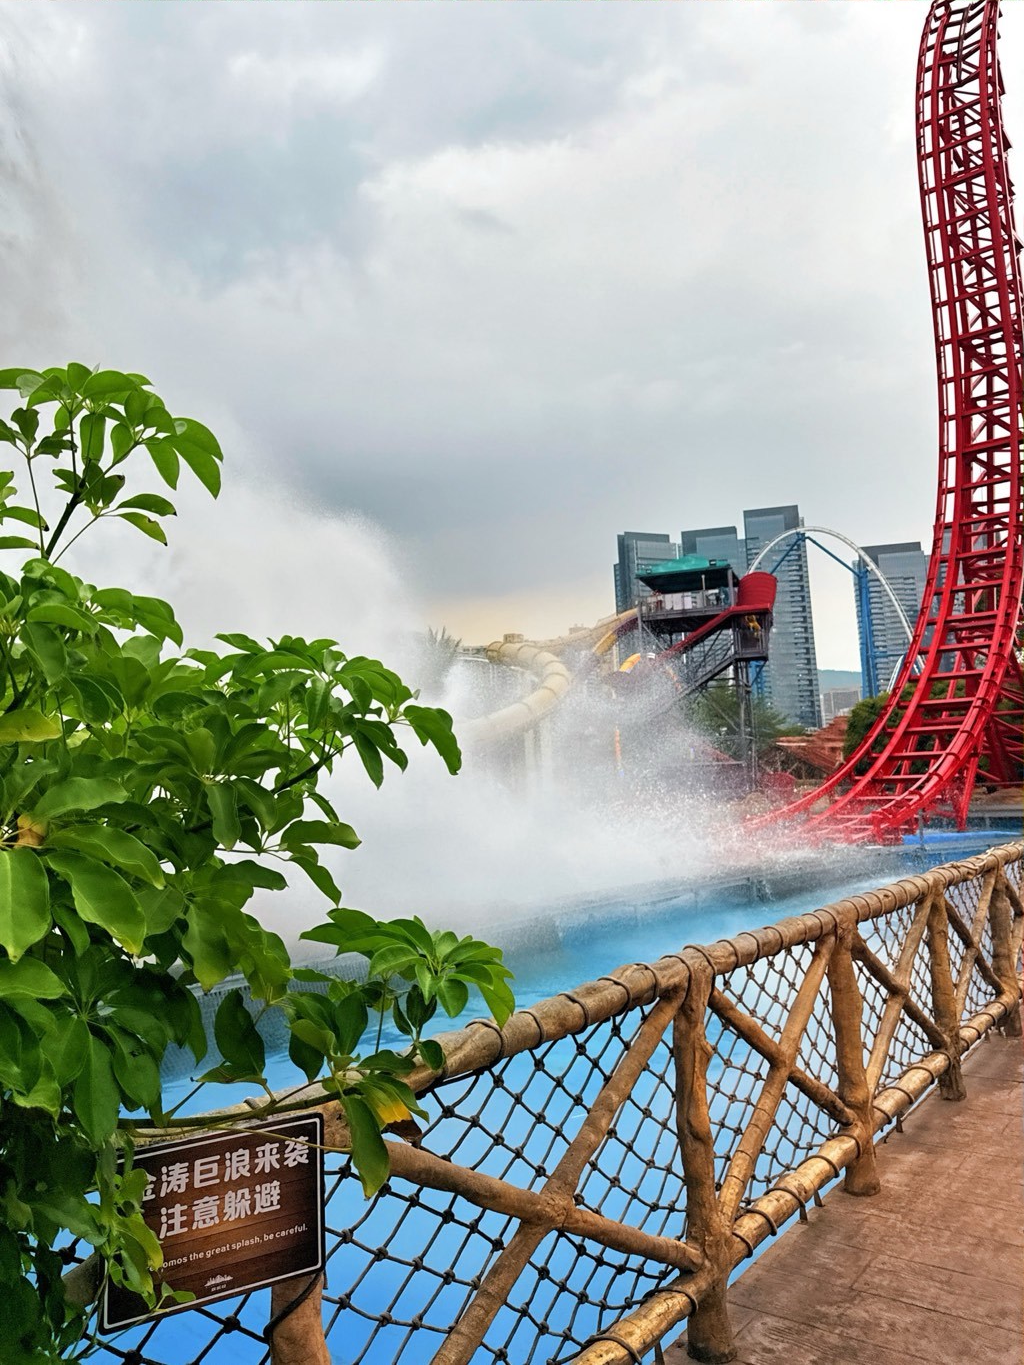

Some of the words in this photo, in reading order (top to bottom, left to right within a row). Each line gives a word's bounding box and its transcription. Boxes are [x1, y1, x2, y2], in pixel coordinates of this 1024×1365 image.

[158, 1179, 281, 1240] 注意躲避
[162, 1255, 188, 1269] omos
[189, 1251, 205, 1262] the
[205, 1243, 231, 1259] great
[231, 1235, 263, 1252] splash,
[263, 1232, 275, 1241] be
[275, 1223, 308, 1238] careful.
